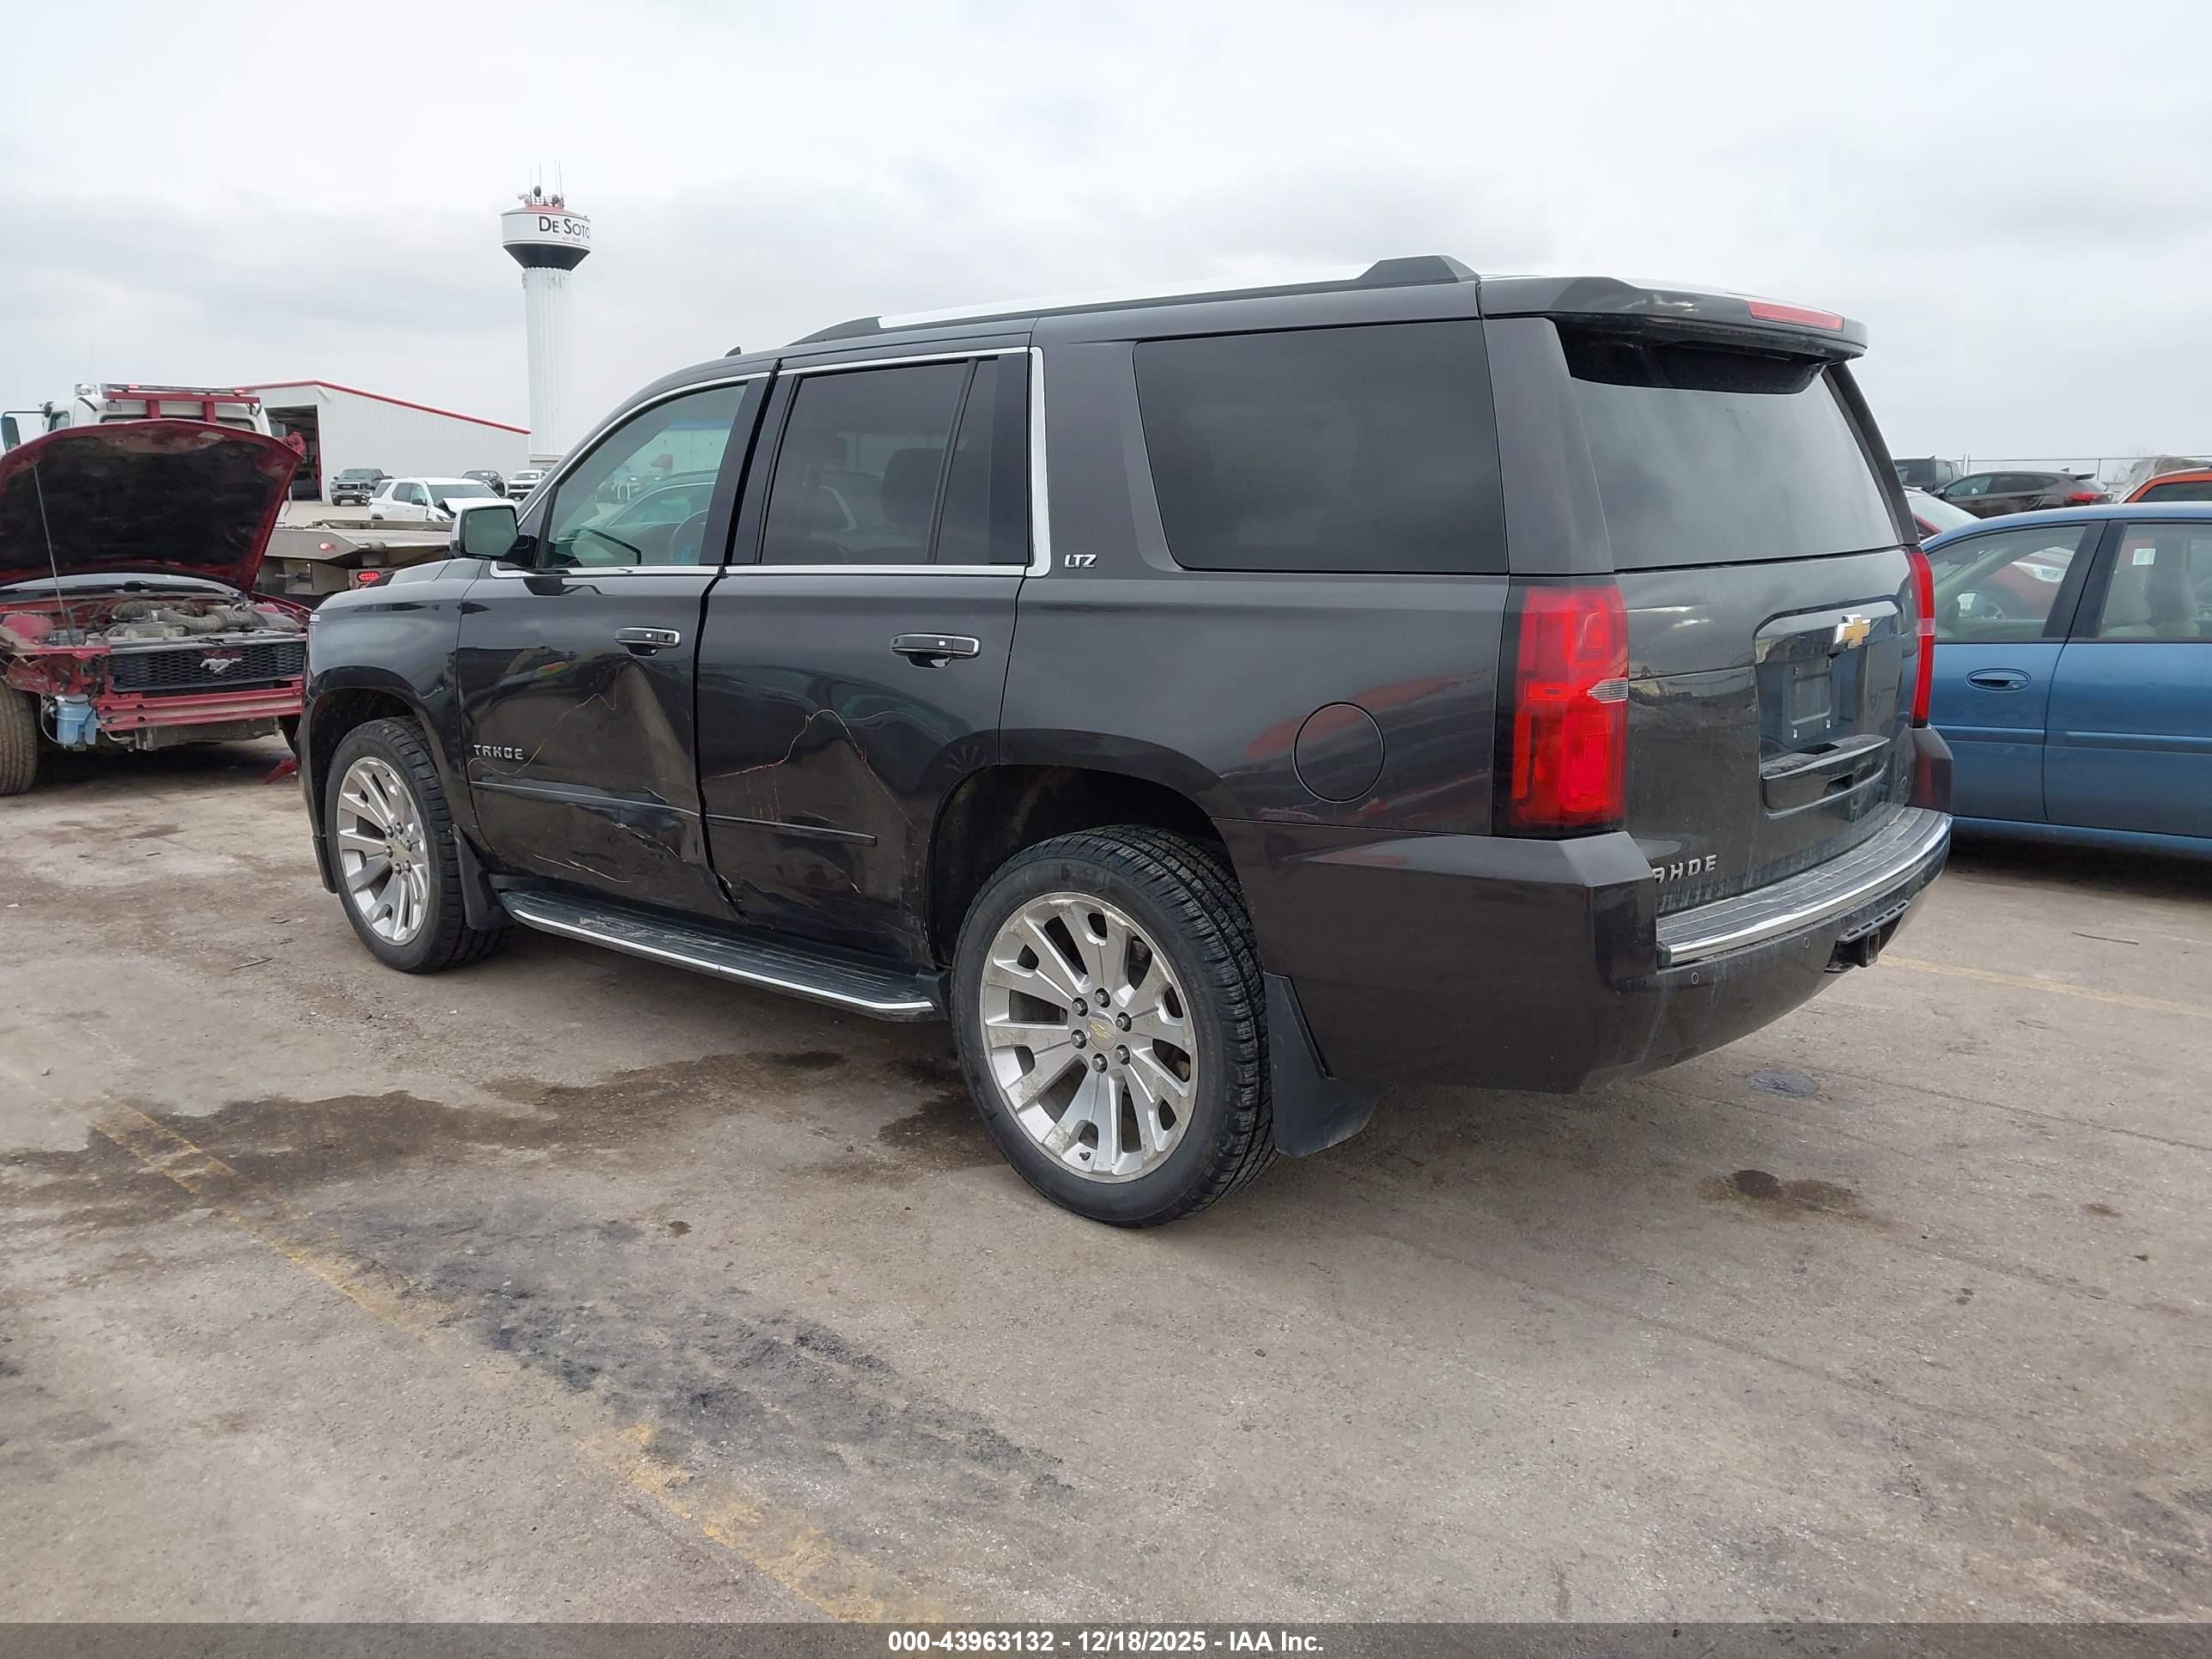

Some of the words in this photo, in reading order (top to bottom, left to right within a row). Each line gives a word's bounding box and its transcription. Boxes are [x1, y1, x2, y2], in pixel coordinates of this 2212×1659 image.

[1064, 554, 1097, 568] LTZ
[473, 744, 524, 760] TAHOE
[1651, 854, 1717, 884] AHOE
